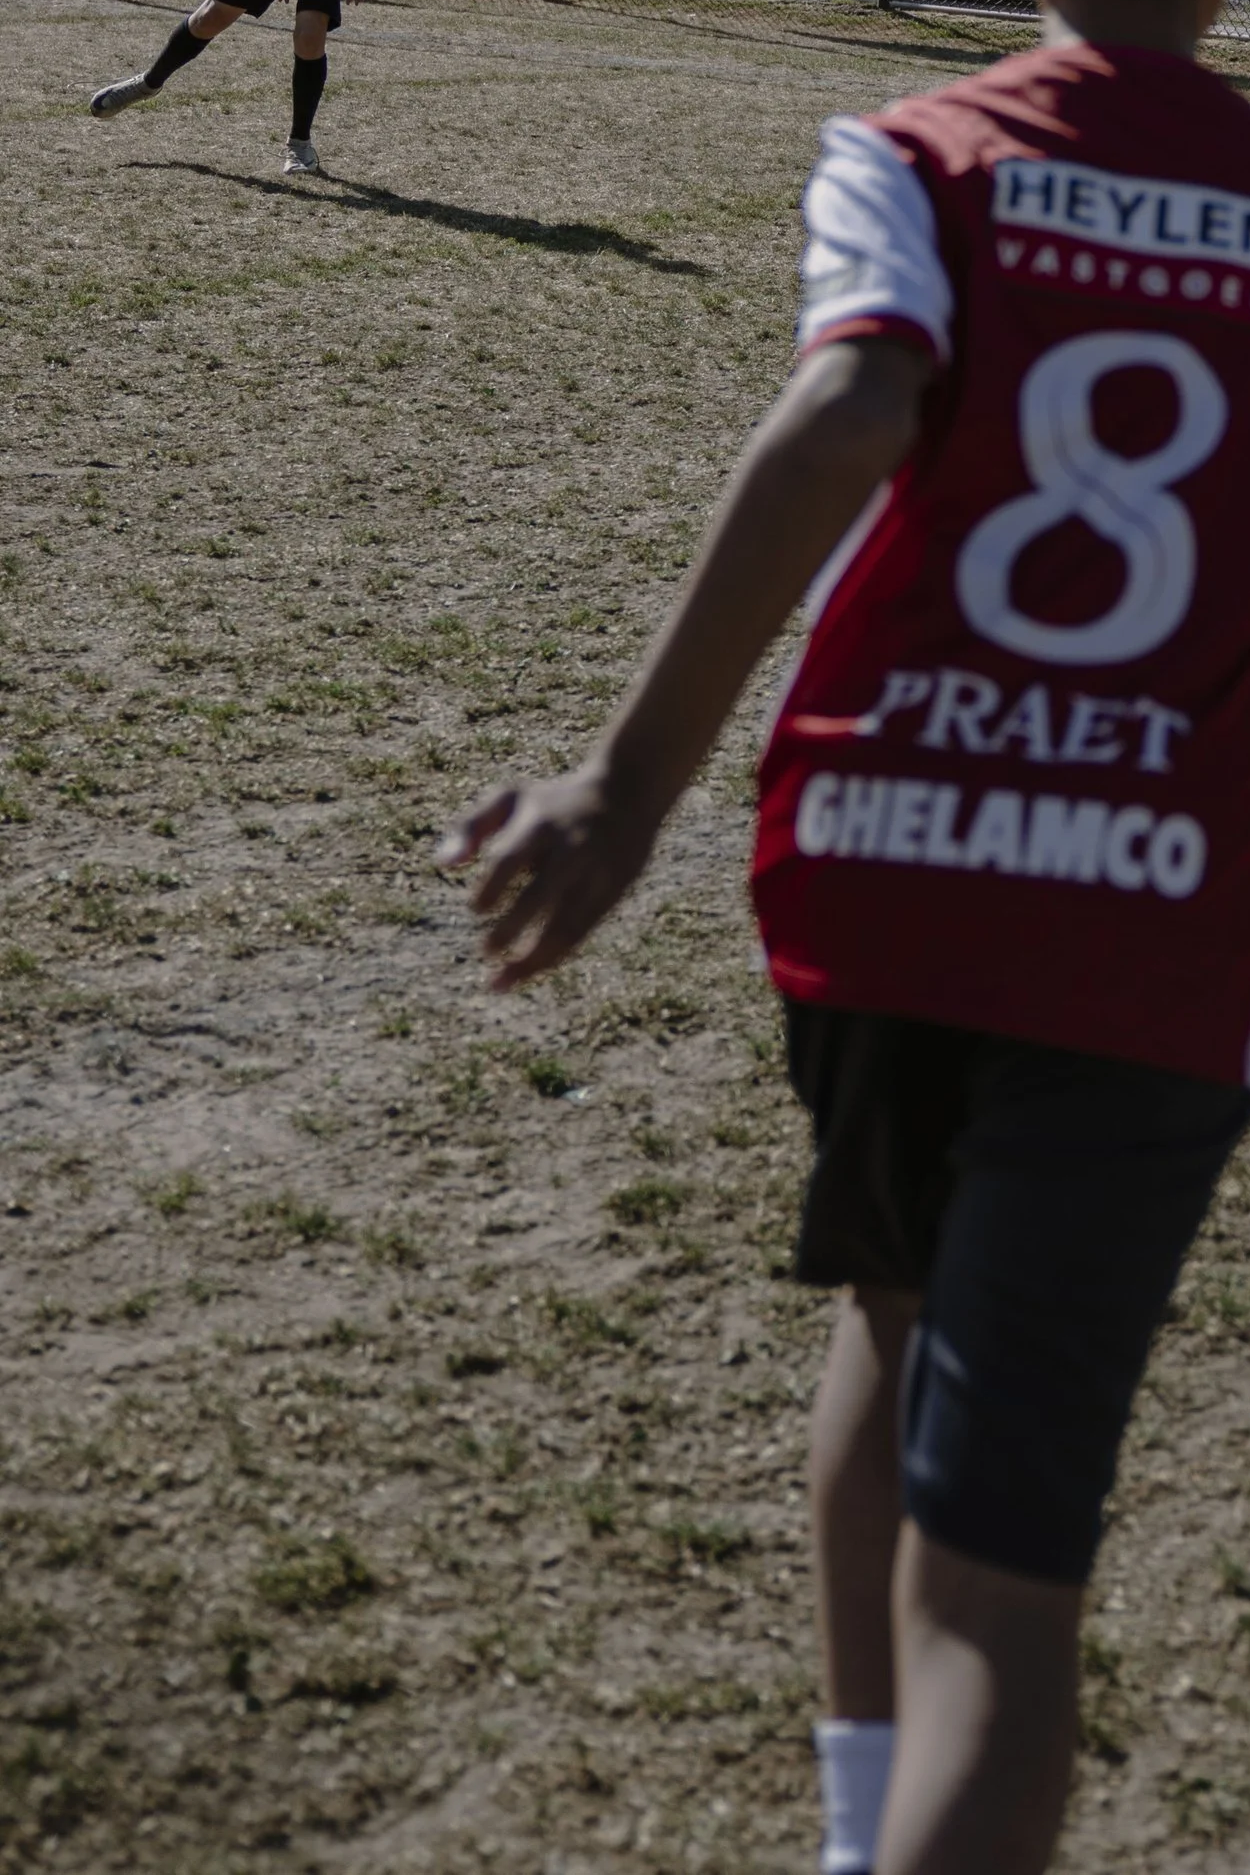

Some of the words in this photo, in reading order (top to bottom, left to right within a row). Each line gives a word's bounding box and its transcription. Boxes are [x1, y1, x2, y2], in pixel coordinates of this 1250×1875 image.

[952, 329, 1230, 668] 8
[855, 664, 1194, 775] PRAET
[795, 769, 1209, 900] GHELAMCO
